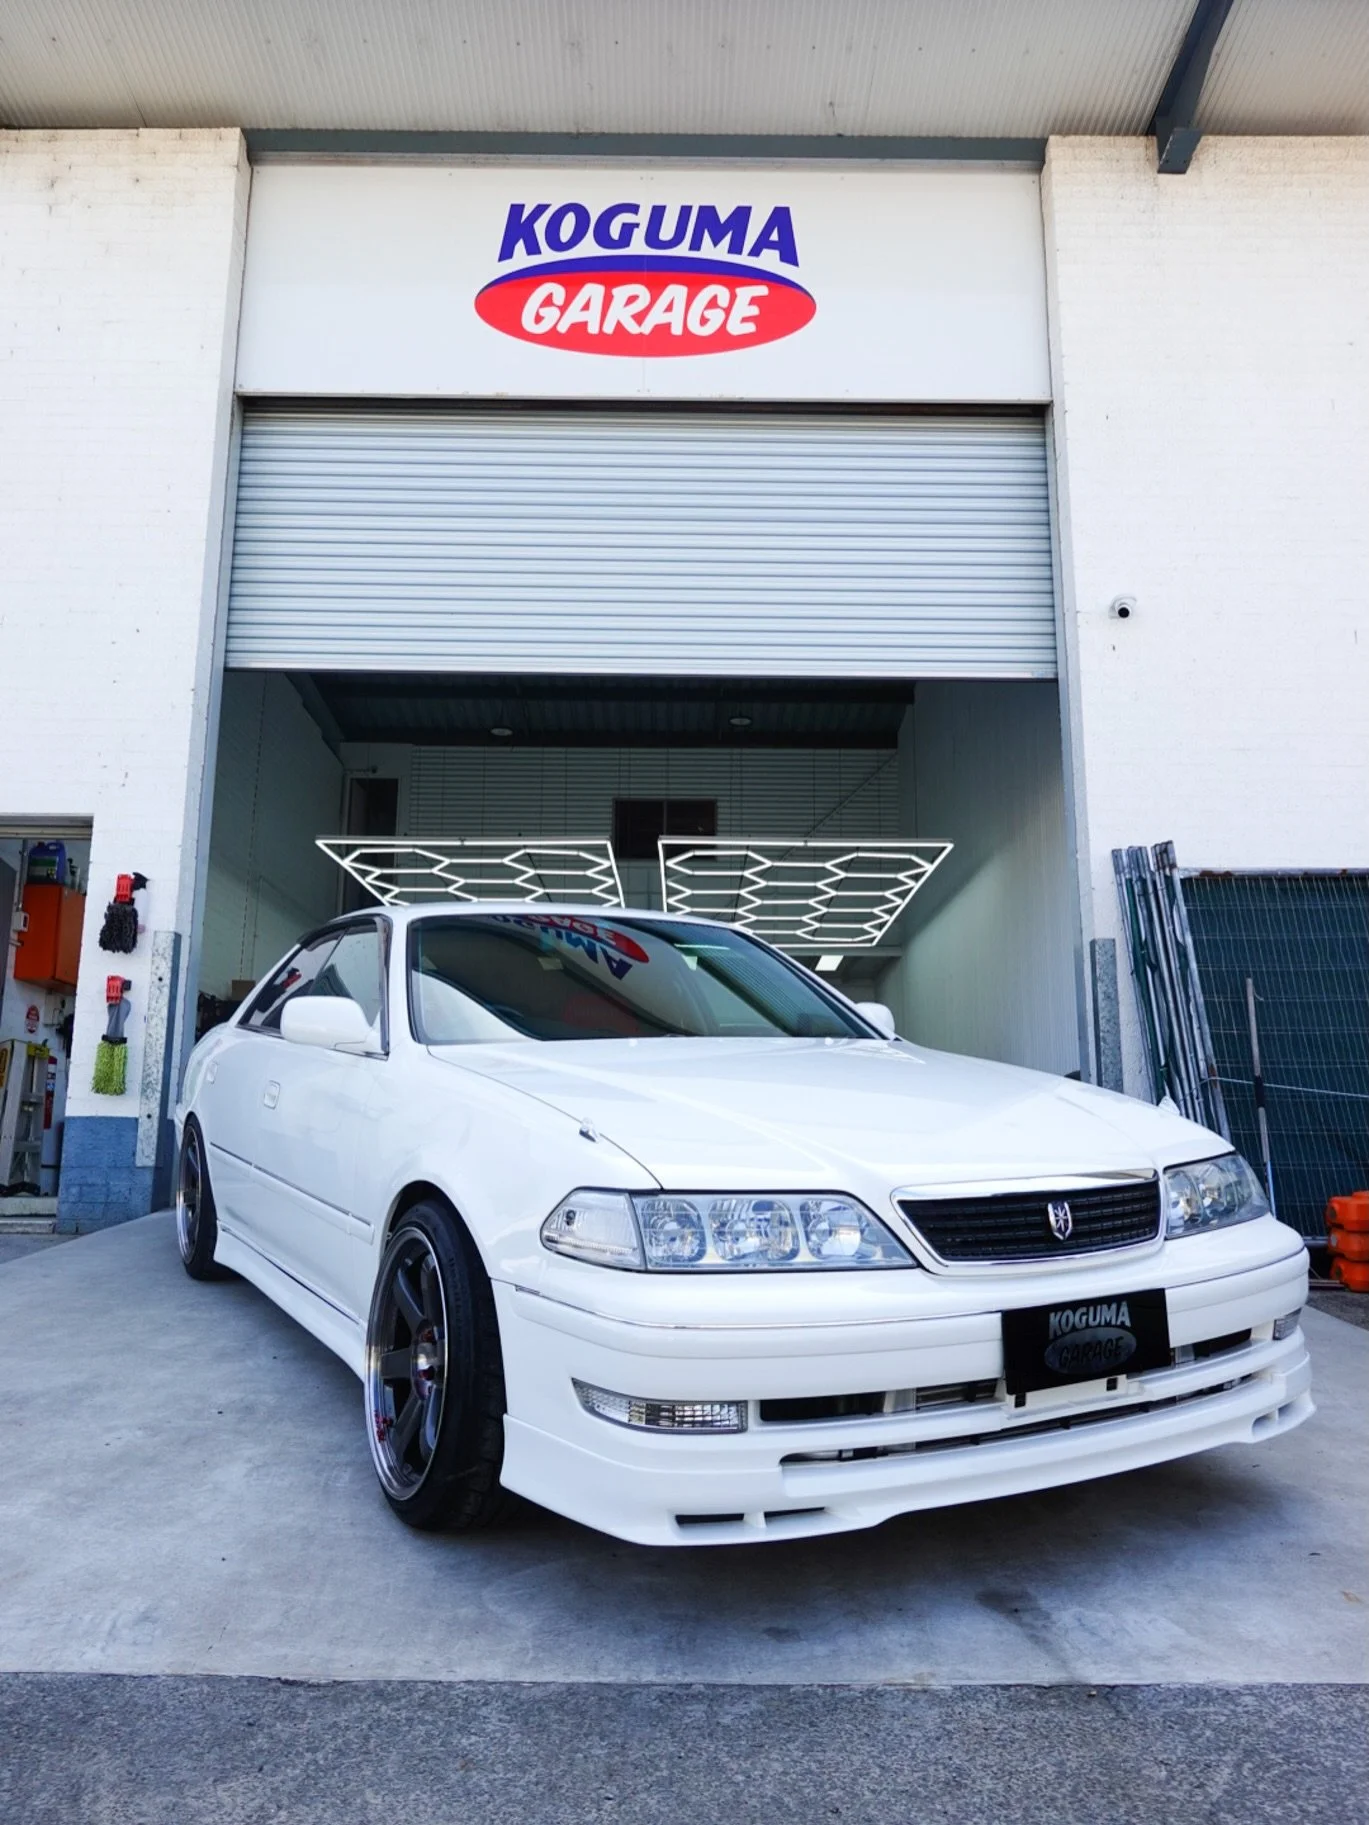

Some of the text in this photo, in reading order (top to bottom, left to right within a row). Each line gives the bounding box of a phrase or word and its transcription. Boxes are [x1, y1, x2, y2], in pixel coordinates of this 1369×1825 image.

[498, 203, 799, 267] KOGUMA
[521, 282, 769, 336] GARAGE
[1050, 1301, 1131, 1339] KOGUMA
[1059, 1335, 1125, 1366] GARAGE
